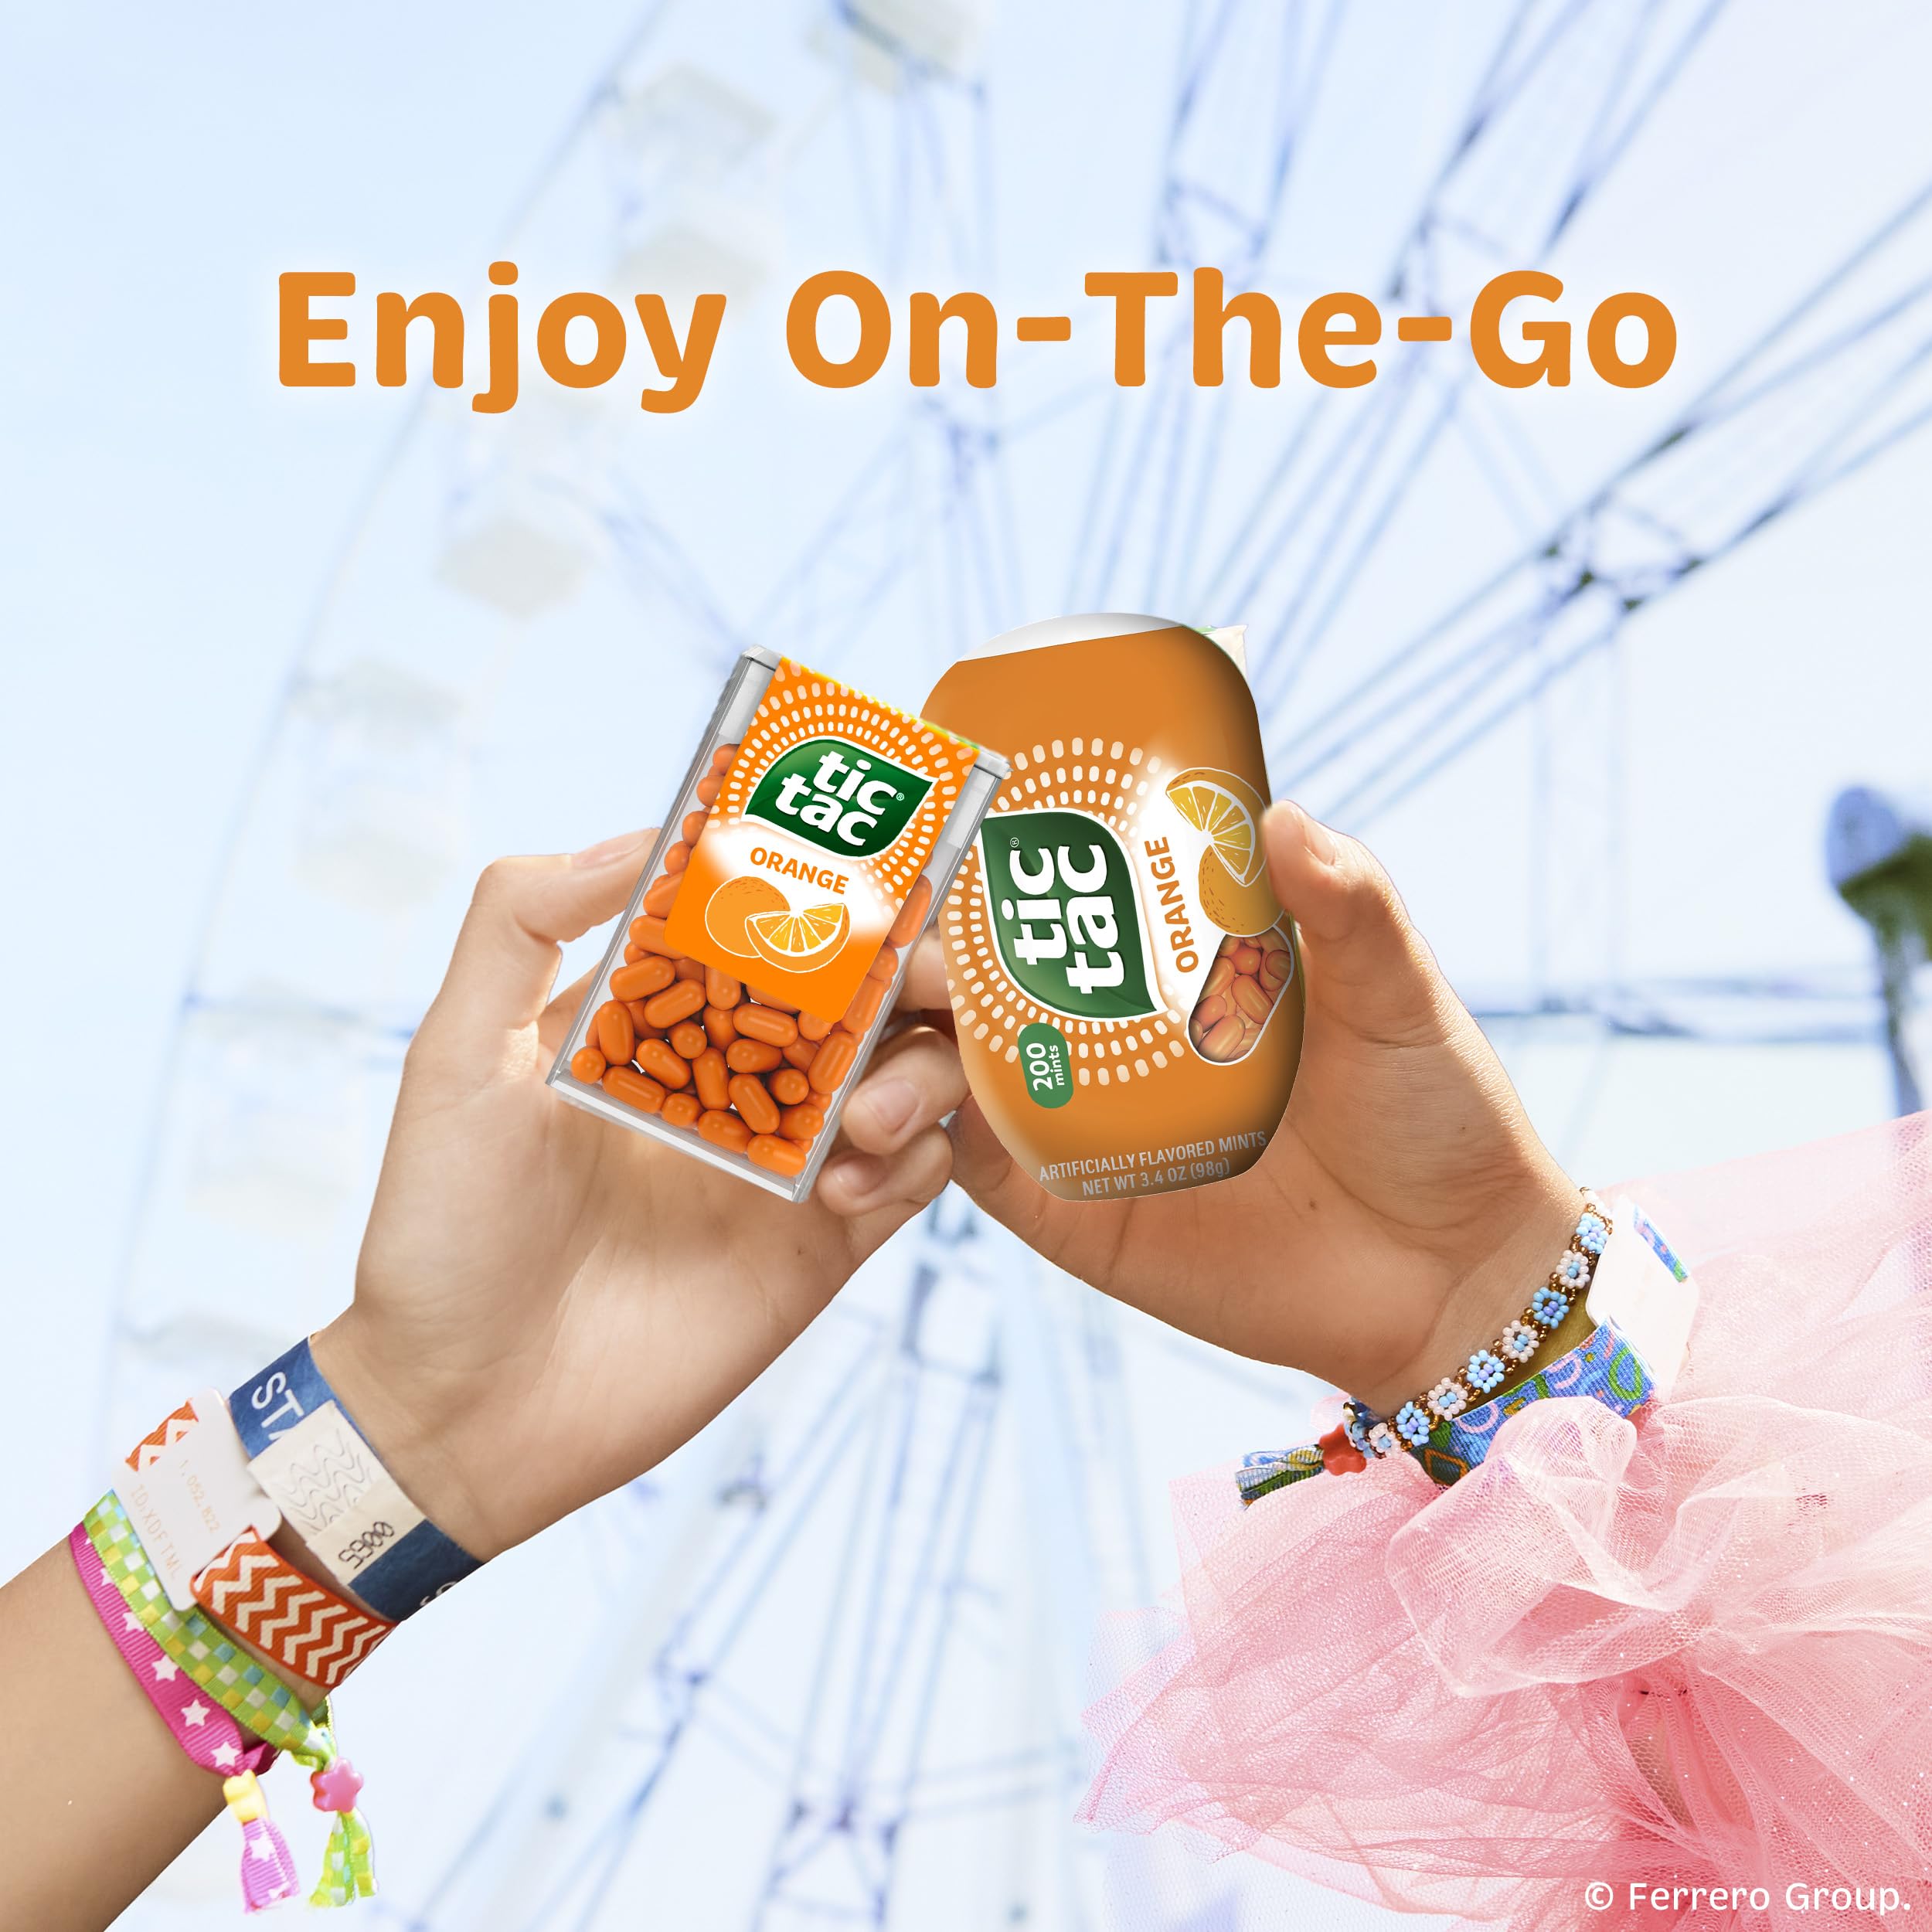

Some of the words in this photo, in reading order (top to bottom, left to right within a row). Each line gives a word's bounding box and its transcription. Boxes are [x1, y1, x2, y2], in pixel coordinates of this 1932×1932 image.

[775, 774, 877, 846] tac
[750, 847, 849, 895] ORANGE
[1056, 845, 1124, 995] tac
[1145, 836, 1199, 974] ORANGE
[1026, 1043, 1053, 1091] 200
[1048, 1045, 1065, 1086] mints
[1039, 1154, 1134, 1182] ARTIFICIALLY
[1138, 1140, 1215, 1167] FLAVORED
[1218, 1131, 1267, 1153] MINTS
[1082, 1177, 1110, 1196] NET
[1114, 1173, 1136, 1191] WT
[1140, 1170, 1164, 1187] 3.4
[1167, 1165, 1187, 1182] OZ
[1190, 1158, 1230, 1180] (98g)
